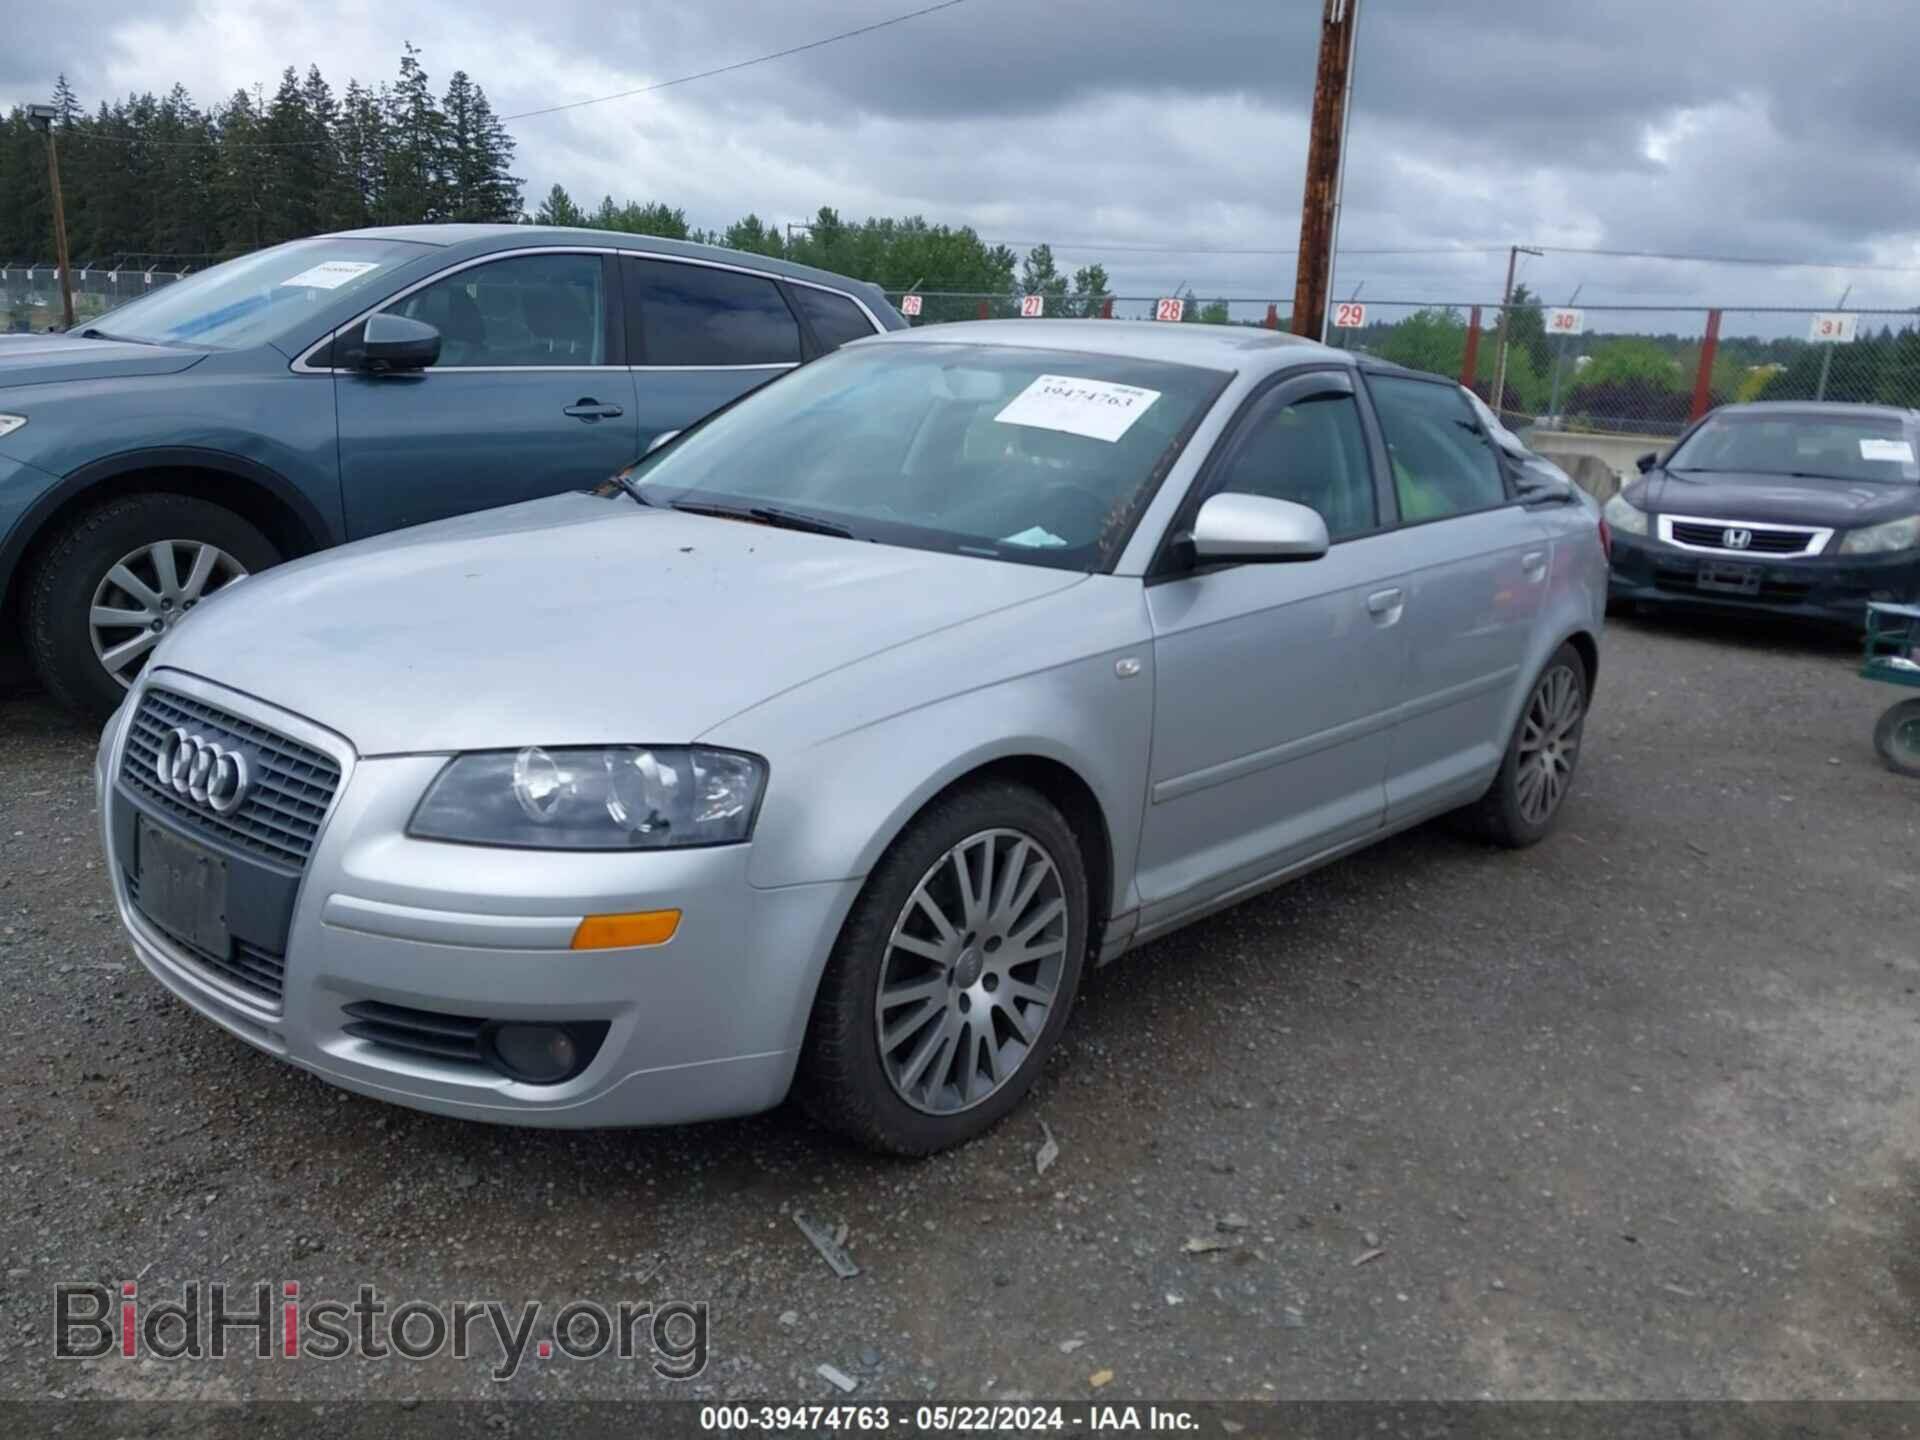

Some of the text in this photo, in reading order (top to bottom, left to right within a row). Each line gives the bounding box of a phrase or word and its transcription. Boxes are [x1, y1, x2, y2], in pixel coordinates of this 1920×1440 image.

[904, 297, 919, 314] 26
[1024, 297, 1041, 315] 27
[1160, 301, 1180, 320] 28
[1338, 305, 1363, 326] 29
[1553, 313, 1574, 328] 30
[1821, 320, 1843, 336] 31
